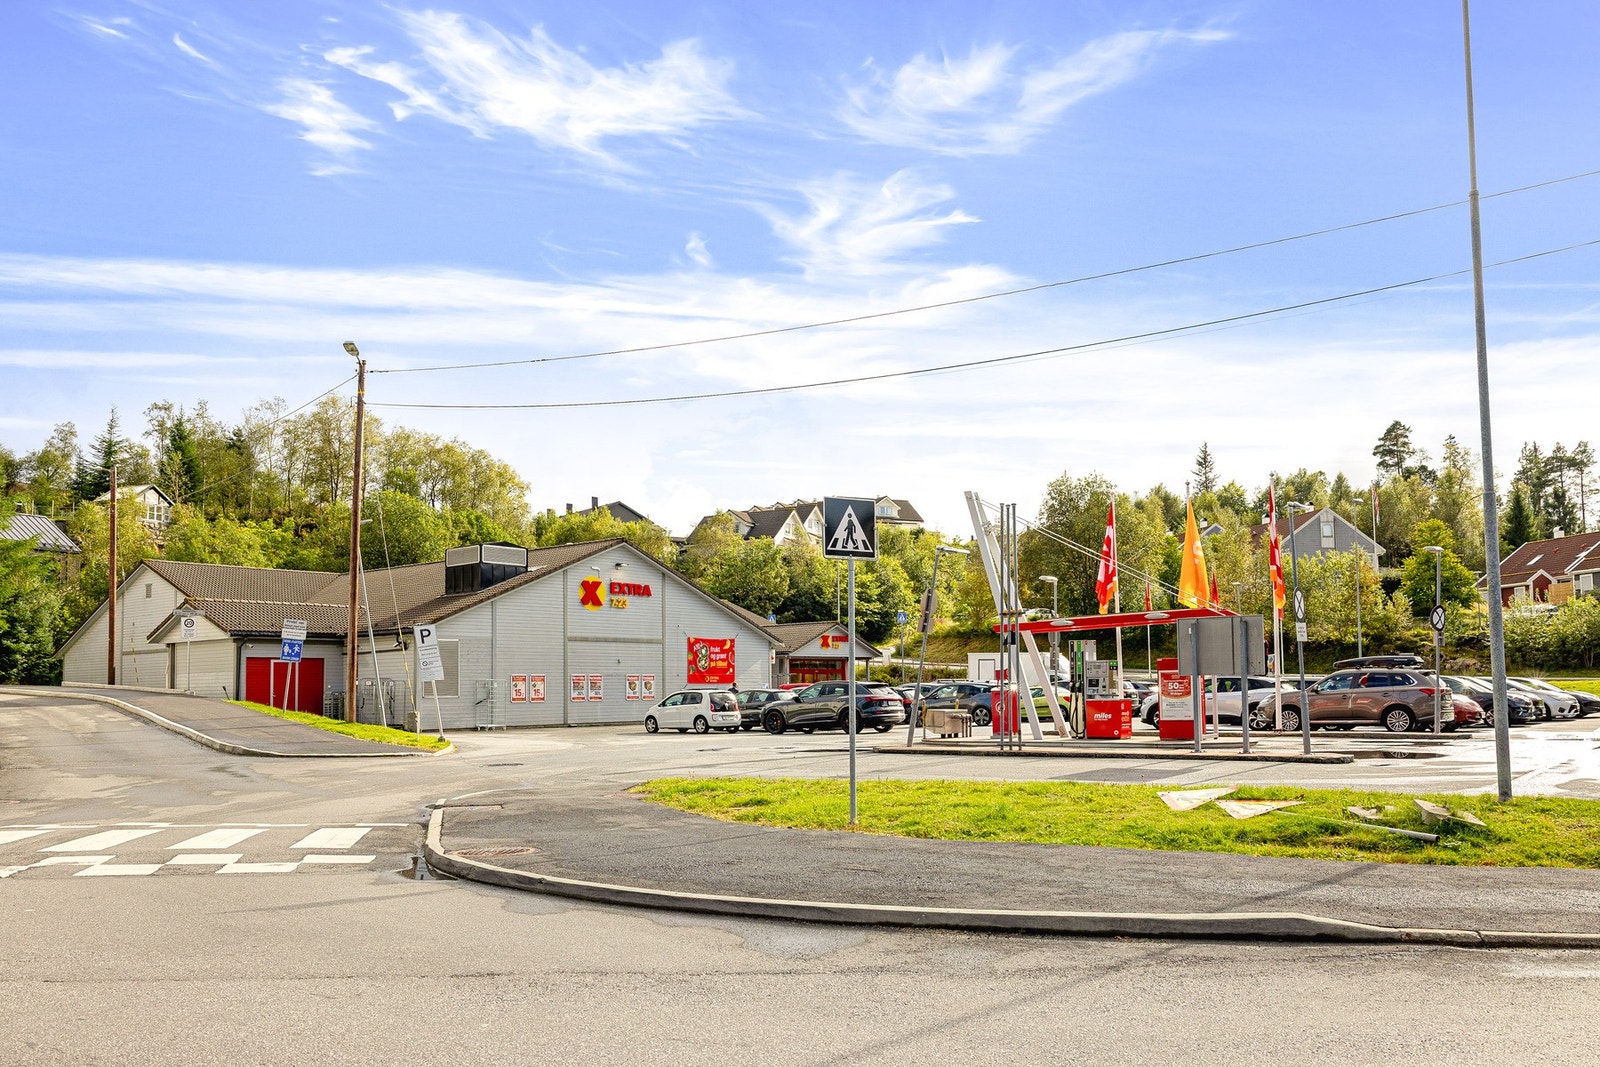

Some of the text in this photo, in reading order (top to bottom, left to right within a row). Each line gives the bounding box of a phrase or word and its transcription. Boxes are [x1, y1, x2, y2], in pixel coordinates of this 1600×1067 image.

[610, 581, 652, 597] EXTRA
[420, 629, 431, 644] P
[832, 635, 849, 643] EXTR
[1168, 682, 1180, 690] 50
